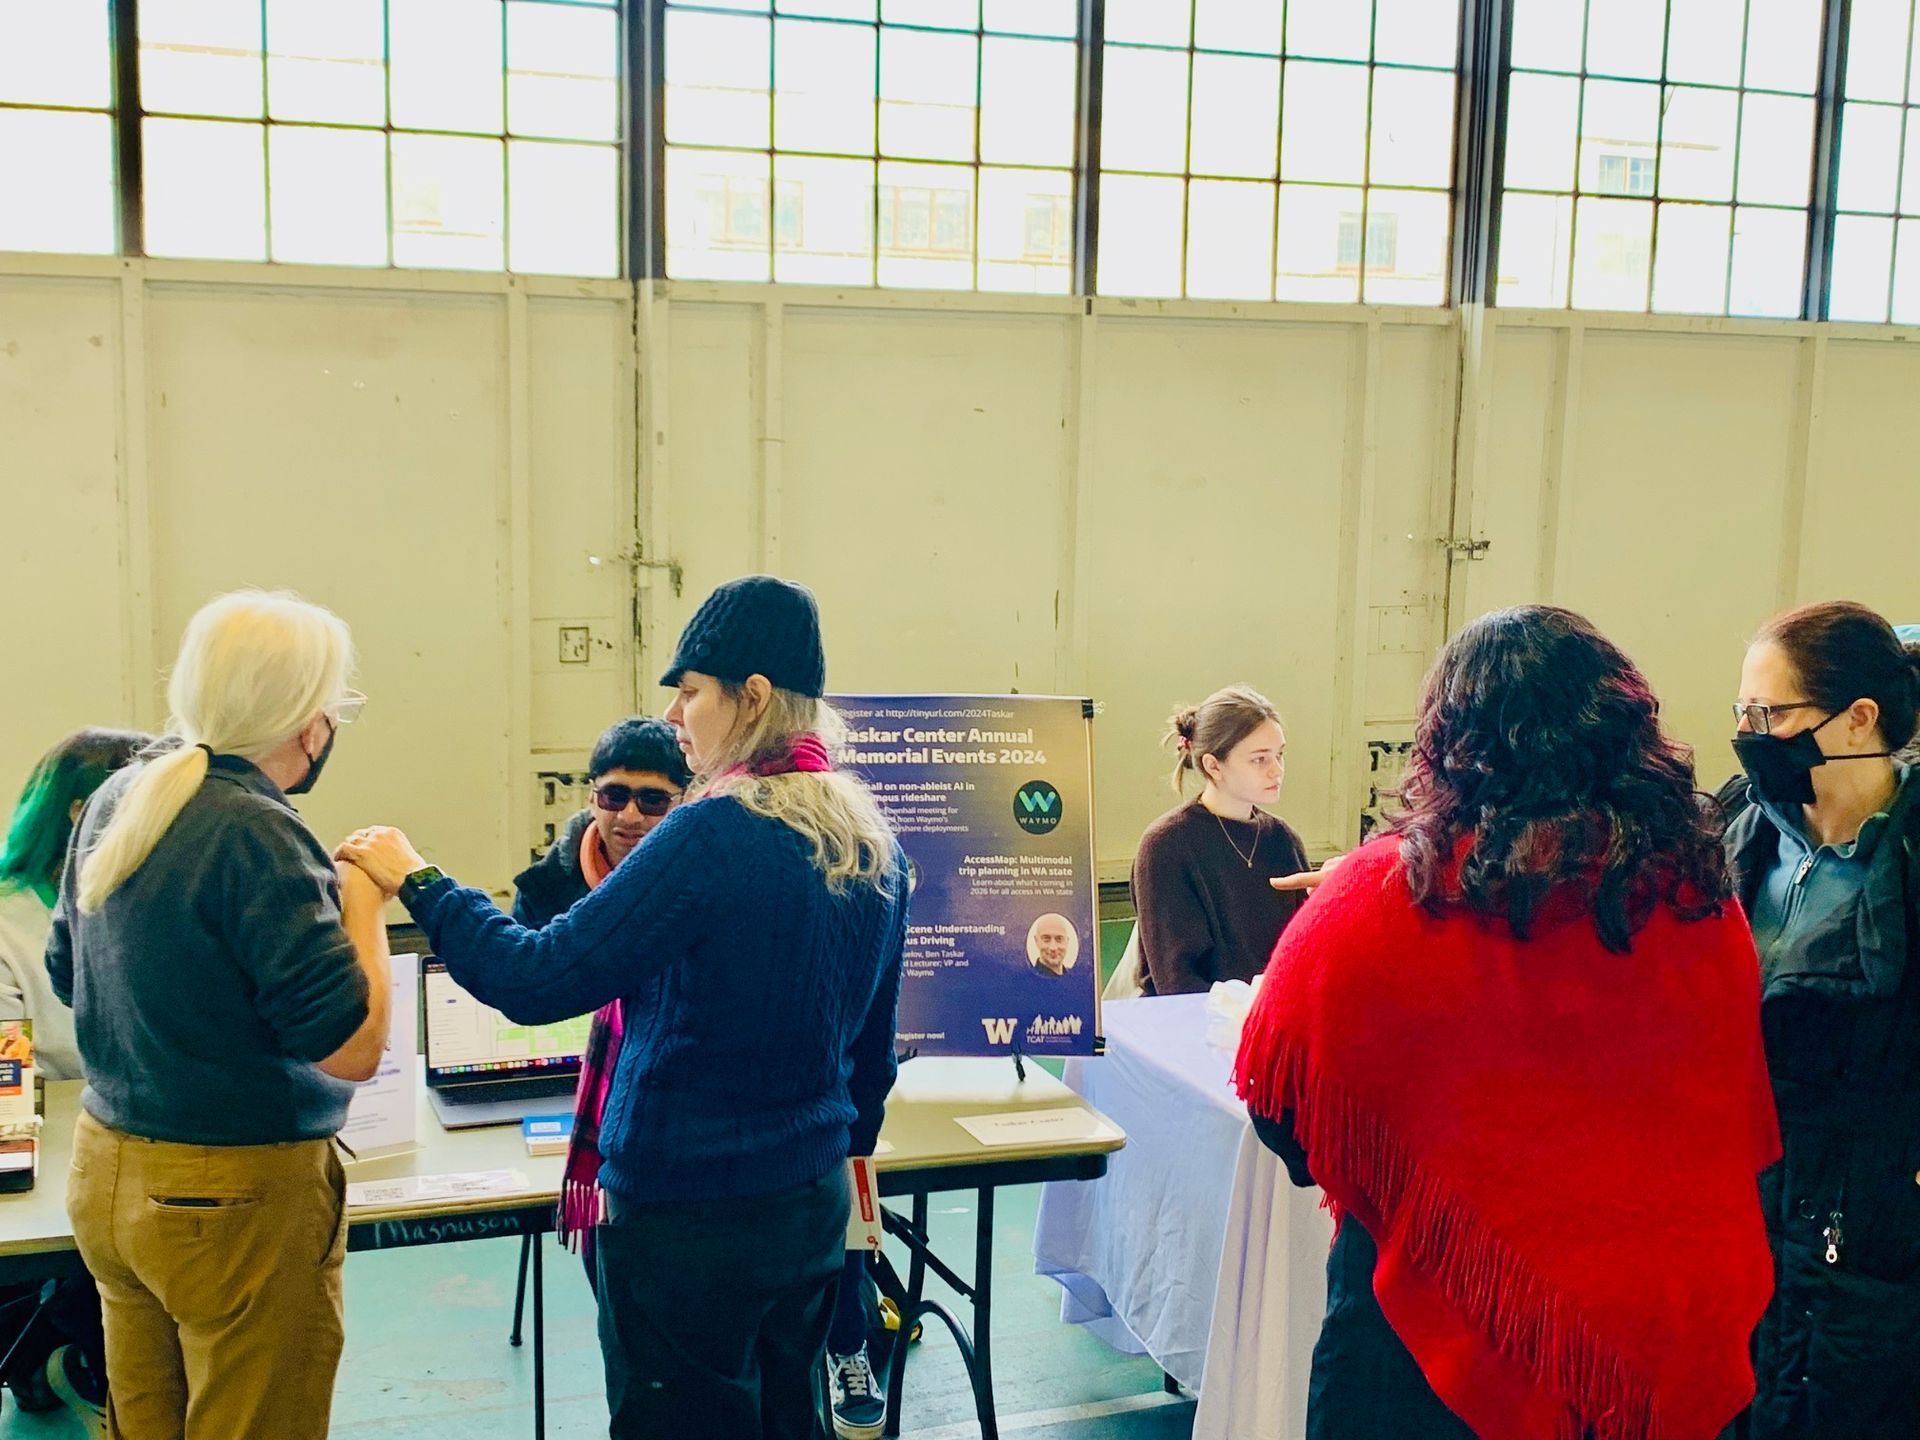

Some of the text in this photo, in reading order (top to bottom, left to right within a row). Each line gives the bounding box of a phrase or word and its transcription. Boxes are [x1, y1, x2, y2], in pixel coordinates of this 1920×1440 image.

[874, 709, 884, 718] at
[885, 709, 1014, 720] http://tinyurl.com/2024Taskar
[840, 727, 1033, 744] Taskar Center Annual
[837, 748, 1047, 765] Memorial Events 2024
[884, 783, 898, 791] on
[899, 781, 952, 791] non-ableist
[965, 781, 975, 791] in
[900, 793, 947, 802] rideshare
[917, 807, 948, 816] meeting
[948, 806, 959, 814] for
[1019, 817, 1057, 825] WAYMO
[923, 825, 969, 834] deployments
[964, 855, 1073, 866] AccessMap: Multimodal
[958, 866, 1073, 877] trip planning in WA state
[972, 879, 993, 887] Learn
[993, 879, 1015, 887] about
[1039, 880, 1066, 888] coming
[1066, 879, 1073, 887] in
[1010, 888, 1034, 896] access
[1042, 888, 1055, 896] WA
[934, 924, 1006, 935] Understanding
[919, 936, 955, 947] Driving
[943, 959, 954, 967] VP
[954, 959, 969, 967] and
[906, 969, 935, 977] Waymo
[981, 1017, 1018, 1045] W
[1026, 1035, 1045, 1043] TCAT
[374, 1216, 520, 1247] Magnuson
